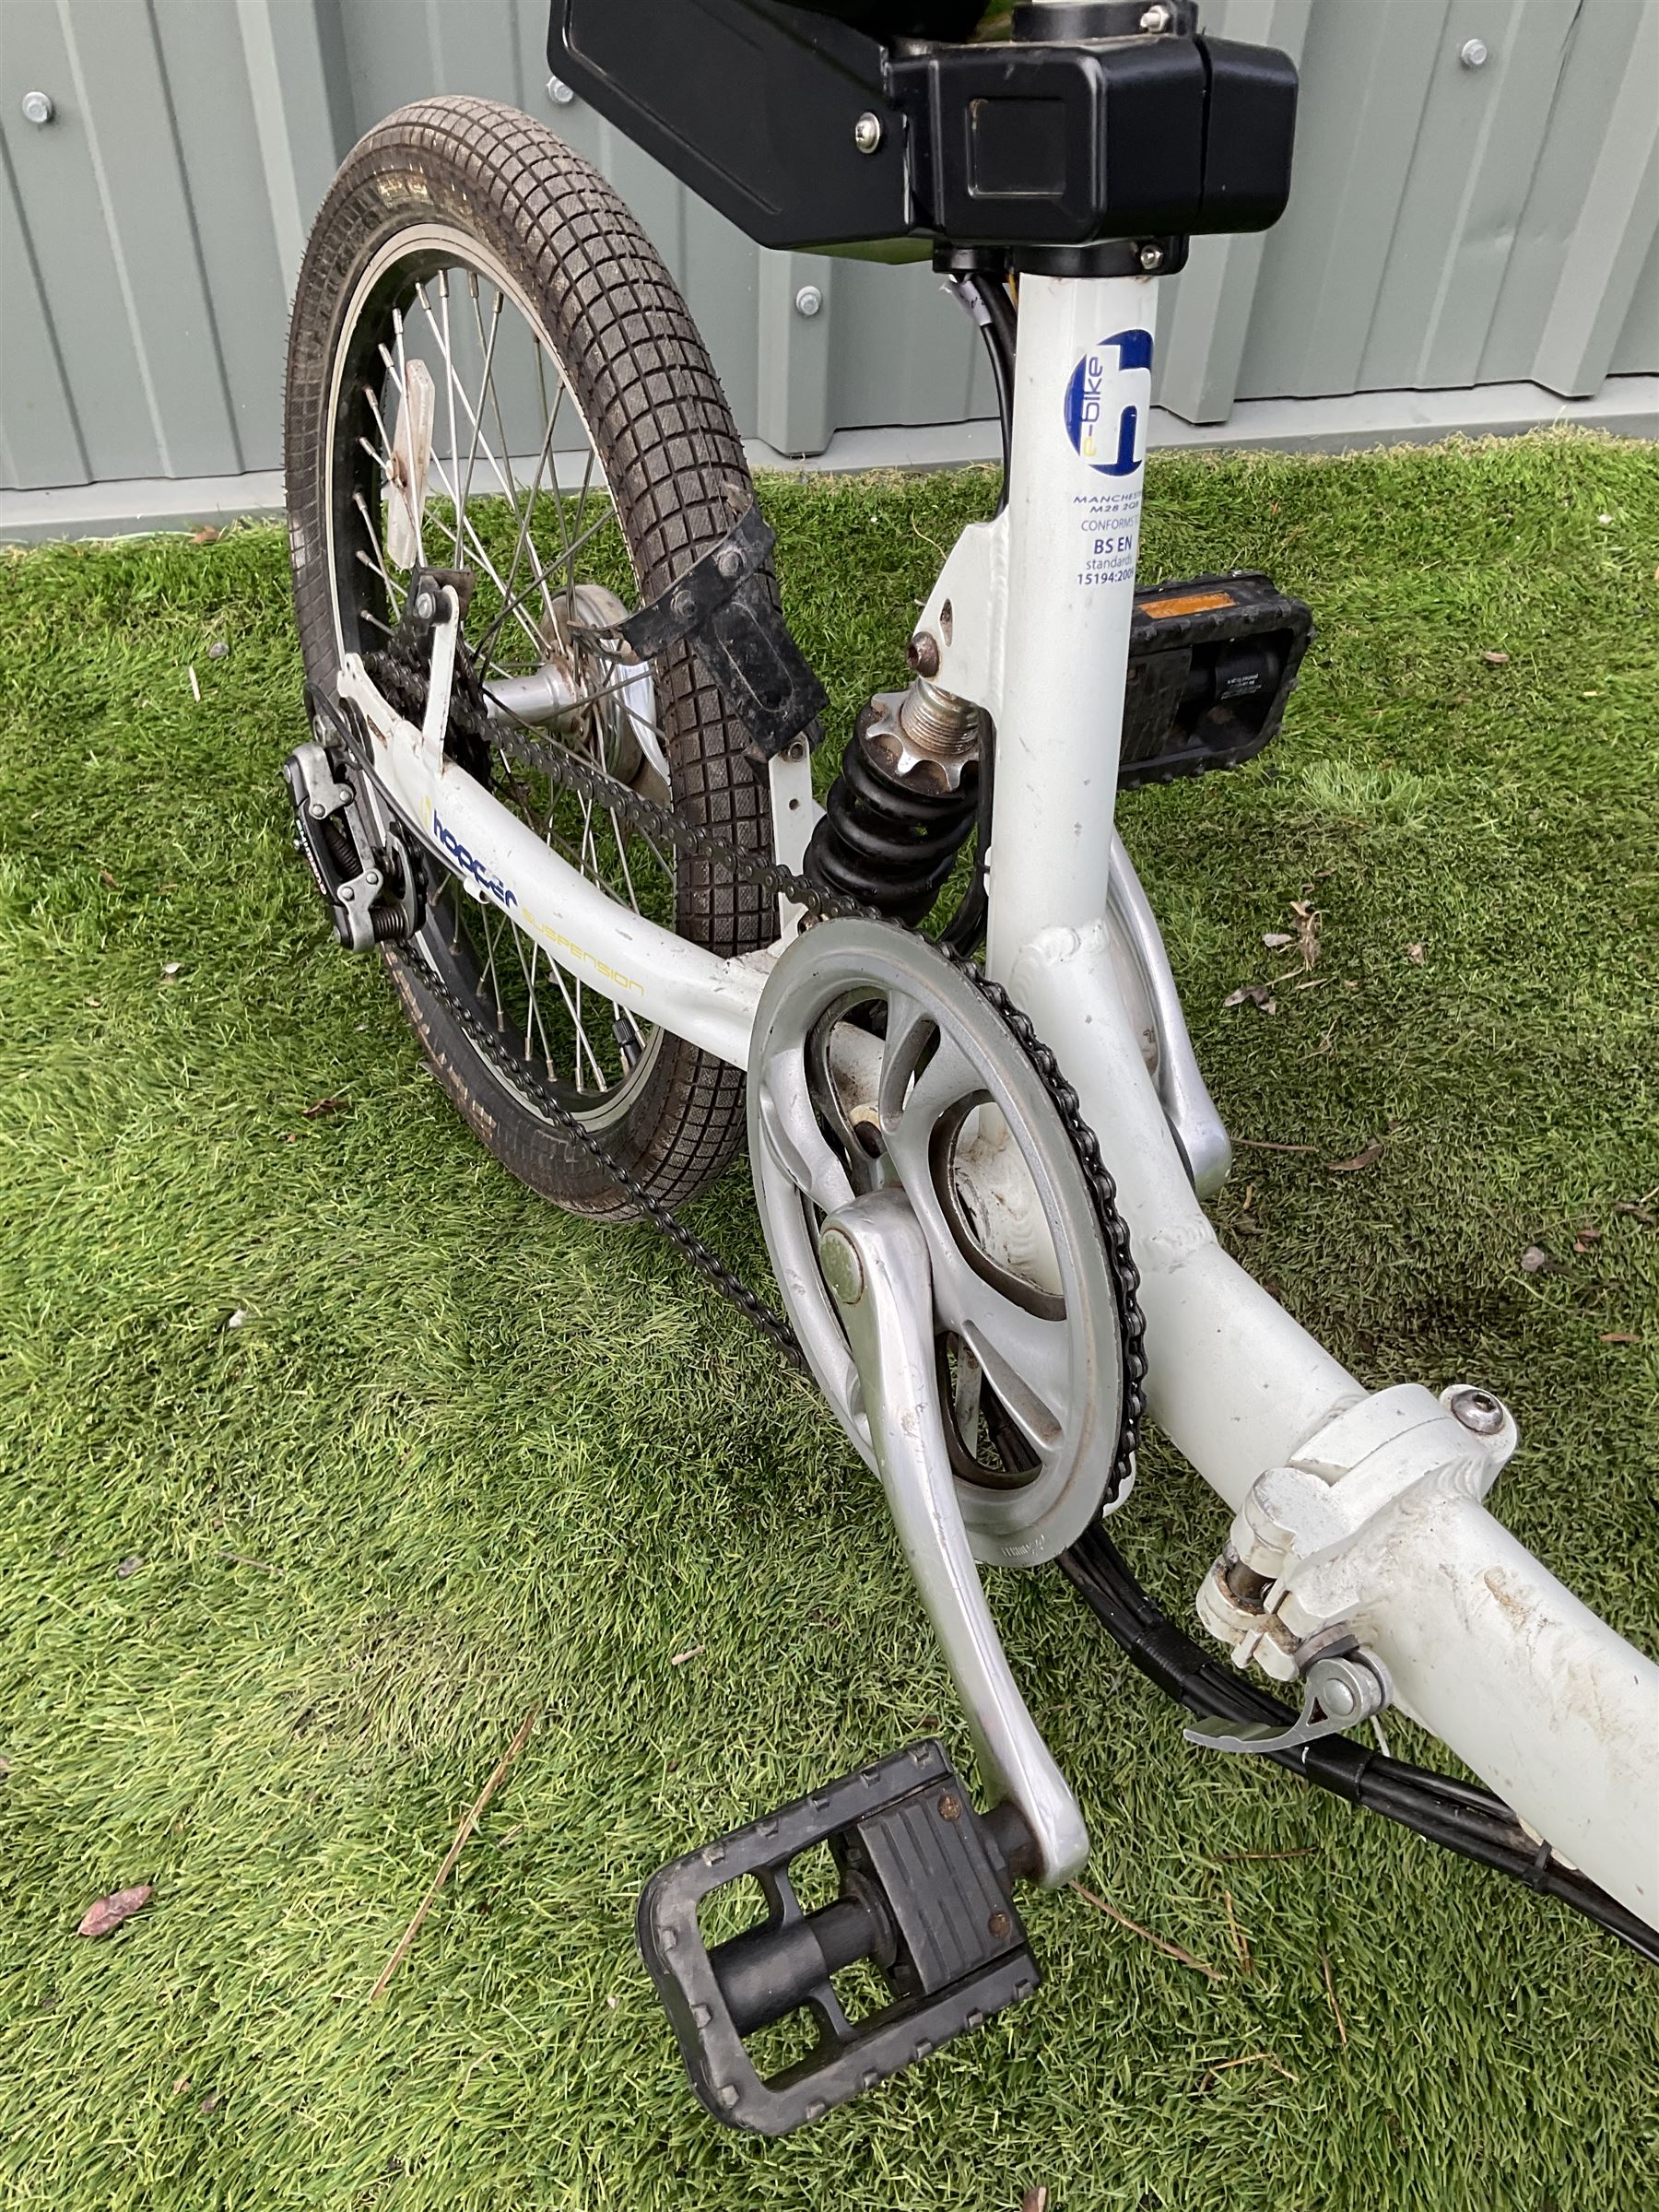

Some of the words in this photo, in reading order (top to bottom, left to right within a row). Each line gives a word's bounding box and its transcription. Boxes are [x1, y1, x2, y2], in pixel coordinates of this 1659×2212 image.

[1083, 357, 1102, 457] e-bike
[1090, 505, 1119, 513] M28
[1094, 538, 1113, 554] BS
[1118, 535, 1132, 552] EN
